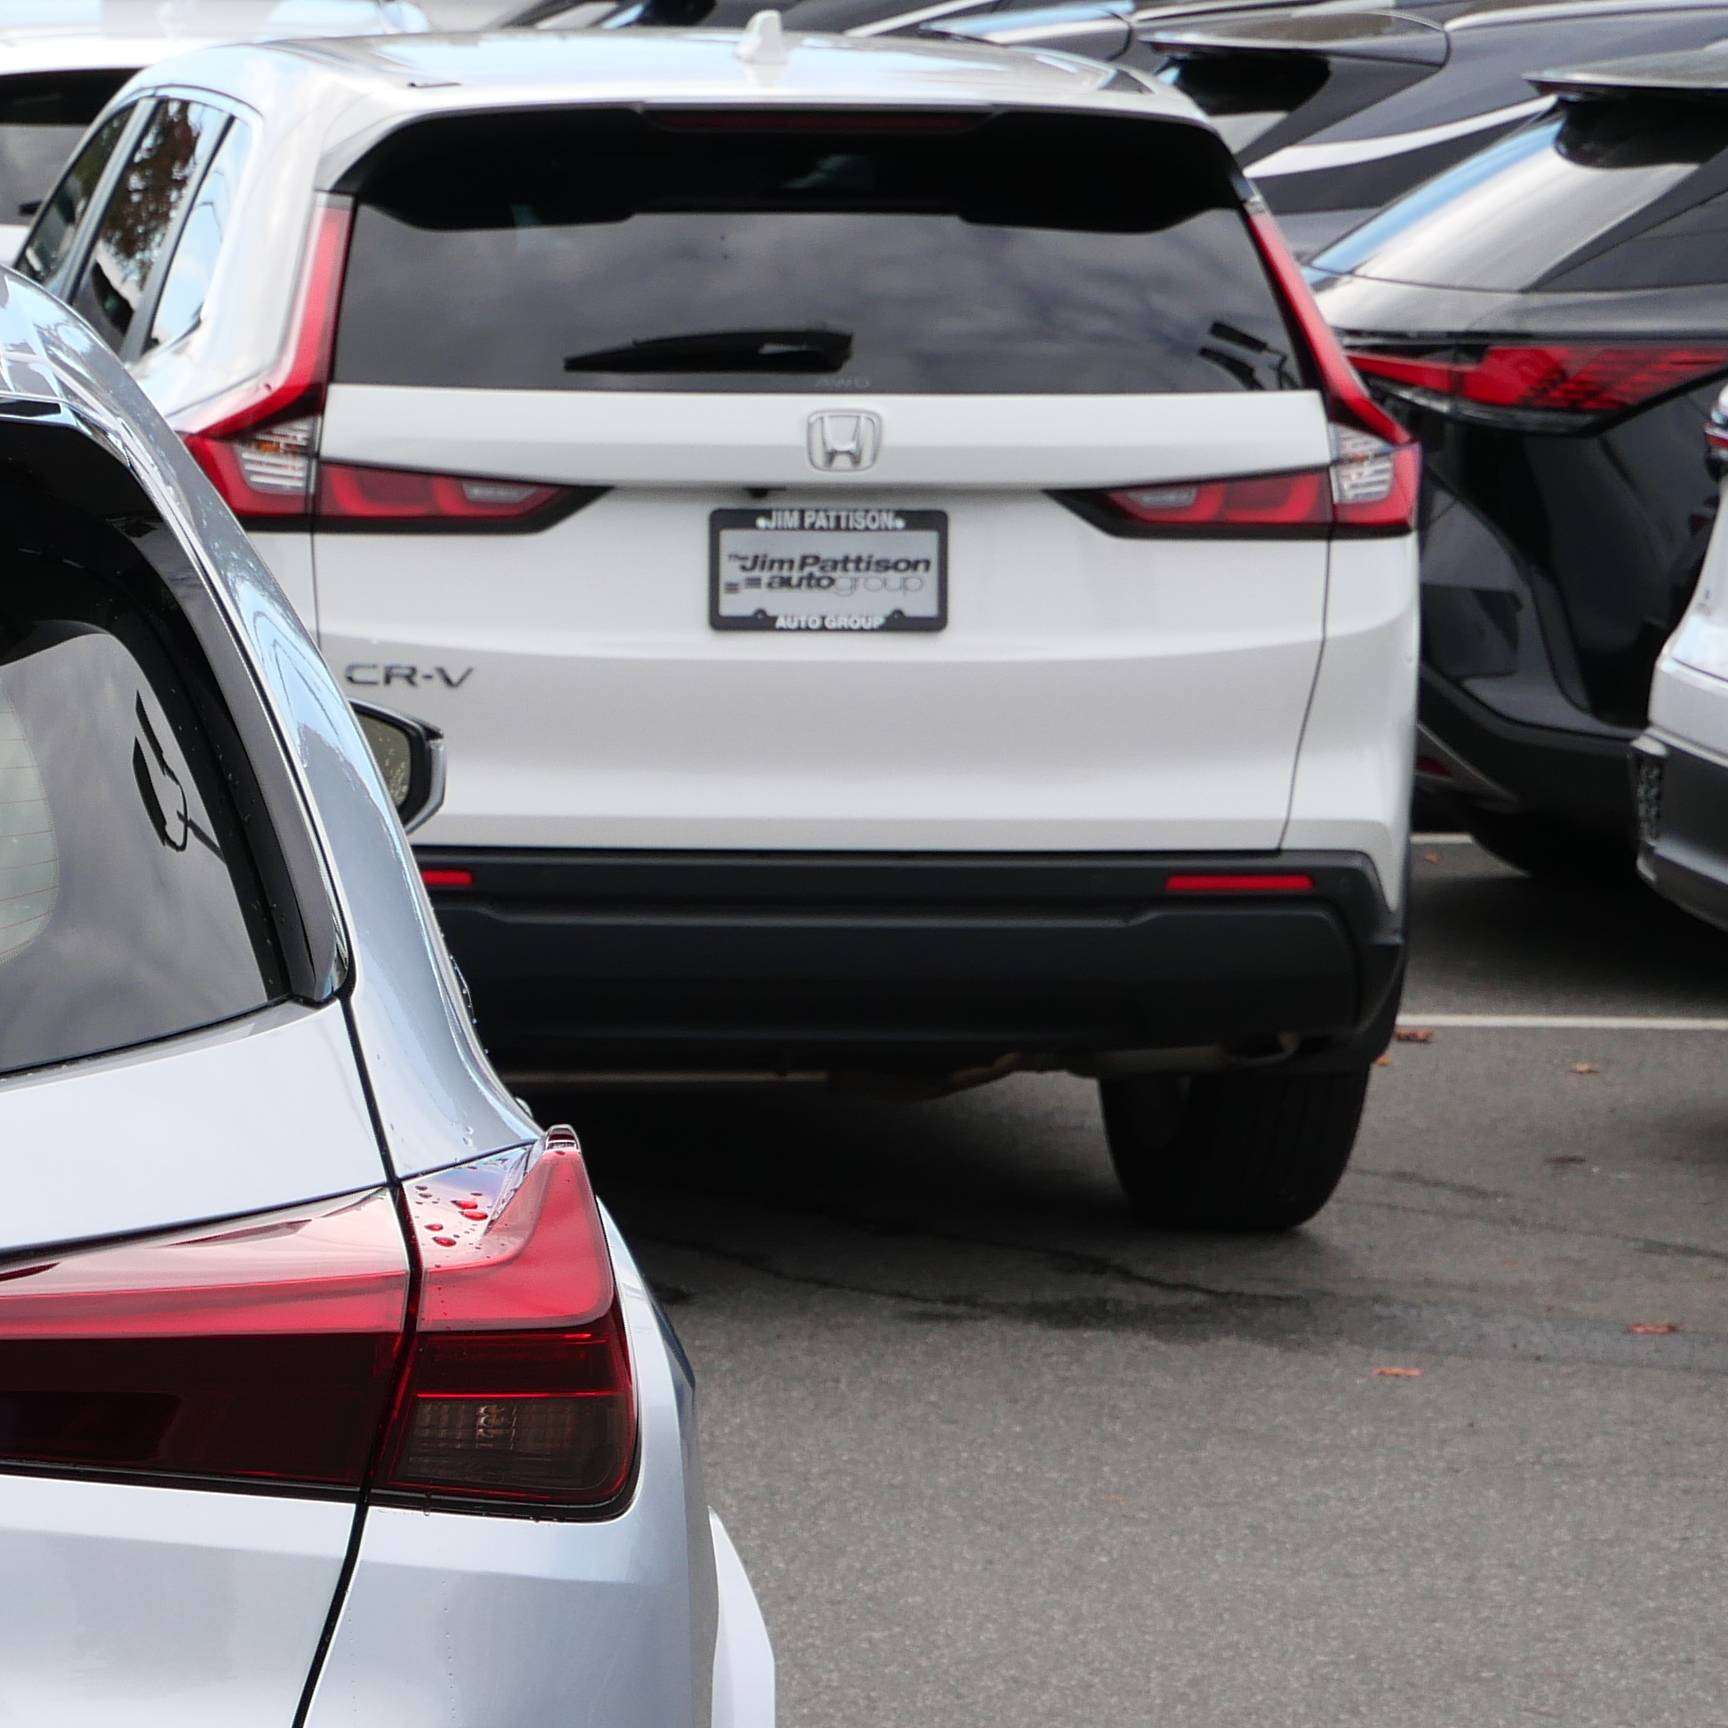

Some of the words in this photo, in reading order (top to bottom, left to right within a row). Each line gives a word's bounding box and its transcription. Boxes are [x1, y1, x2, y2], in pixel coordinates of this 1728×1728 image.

[767, 510, 800, 529] JIM
[804, 510, 893, 530] PATTISON
[775, 615, 823, 630] AUTO
[825, 616, 886, 630] GROUP
[345, 663, 474, 688] CR-V
